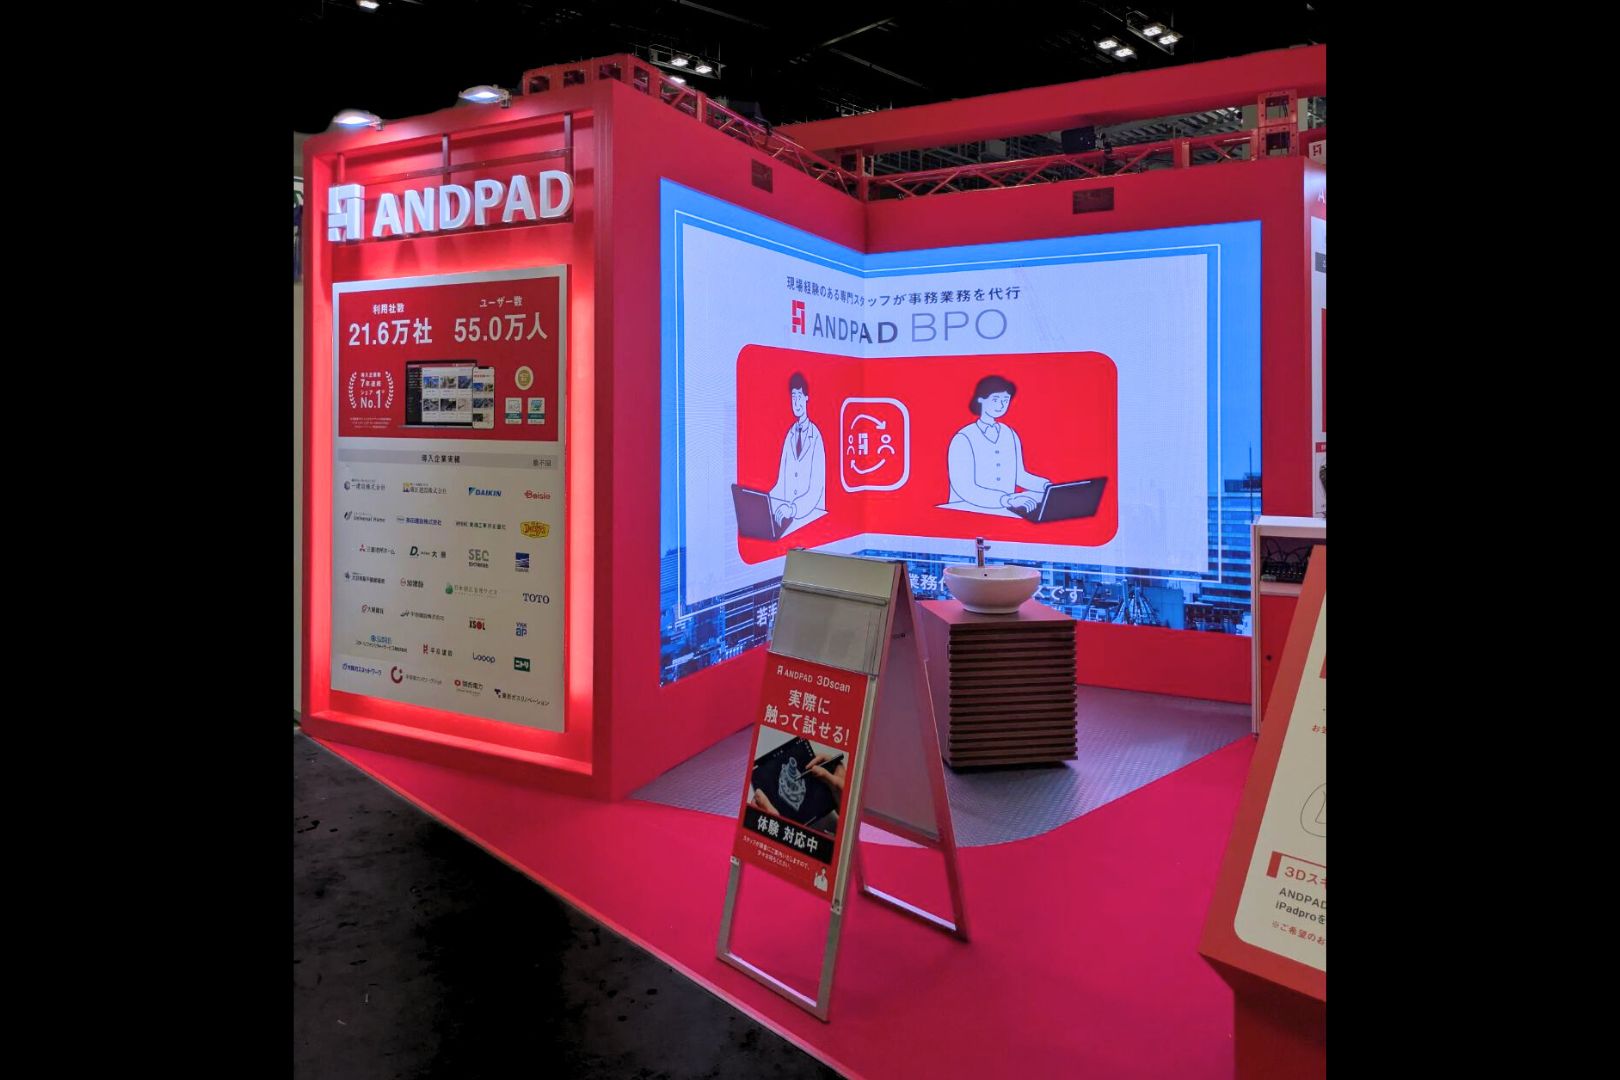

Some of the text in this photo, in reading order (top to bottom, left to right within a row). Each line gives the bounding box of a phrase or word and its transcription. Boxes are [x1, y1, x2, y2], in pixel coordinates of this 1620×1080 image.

[371, 170, 574, 237] ANDPAD
[480, 296, 522, 308] ユーザー数
[786, 276, 1021, 306] 現場経験のある専門スタッフが事務業務を代行
[372, 303, 404, 315] 利用社数
[348, 318, 432, 346] 21.6万社
[454, 312, 548, 343] 55.0万人
[813, 308, 1008, 344] ANDPAD BPO
[475, 489, 502, 497] DAIKIN
[468, 549, 489, 562] SEC
[523, 593, 550, 604] TOTO
[472, 652, 496, 663] Looop
[784, 670, 851, 693] ANDPAD 3Dscan
[789, 689, 831, 715] 実際に
[757, 815, 819, 854] 体験 対応中
